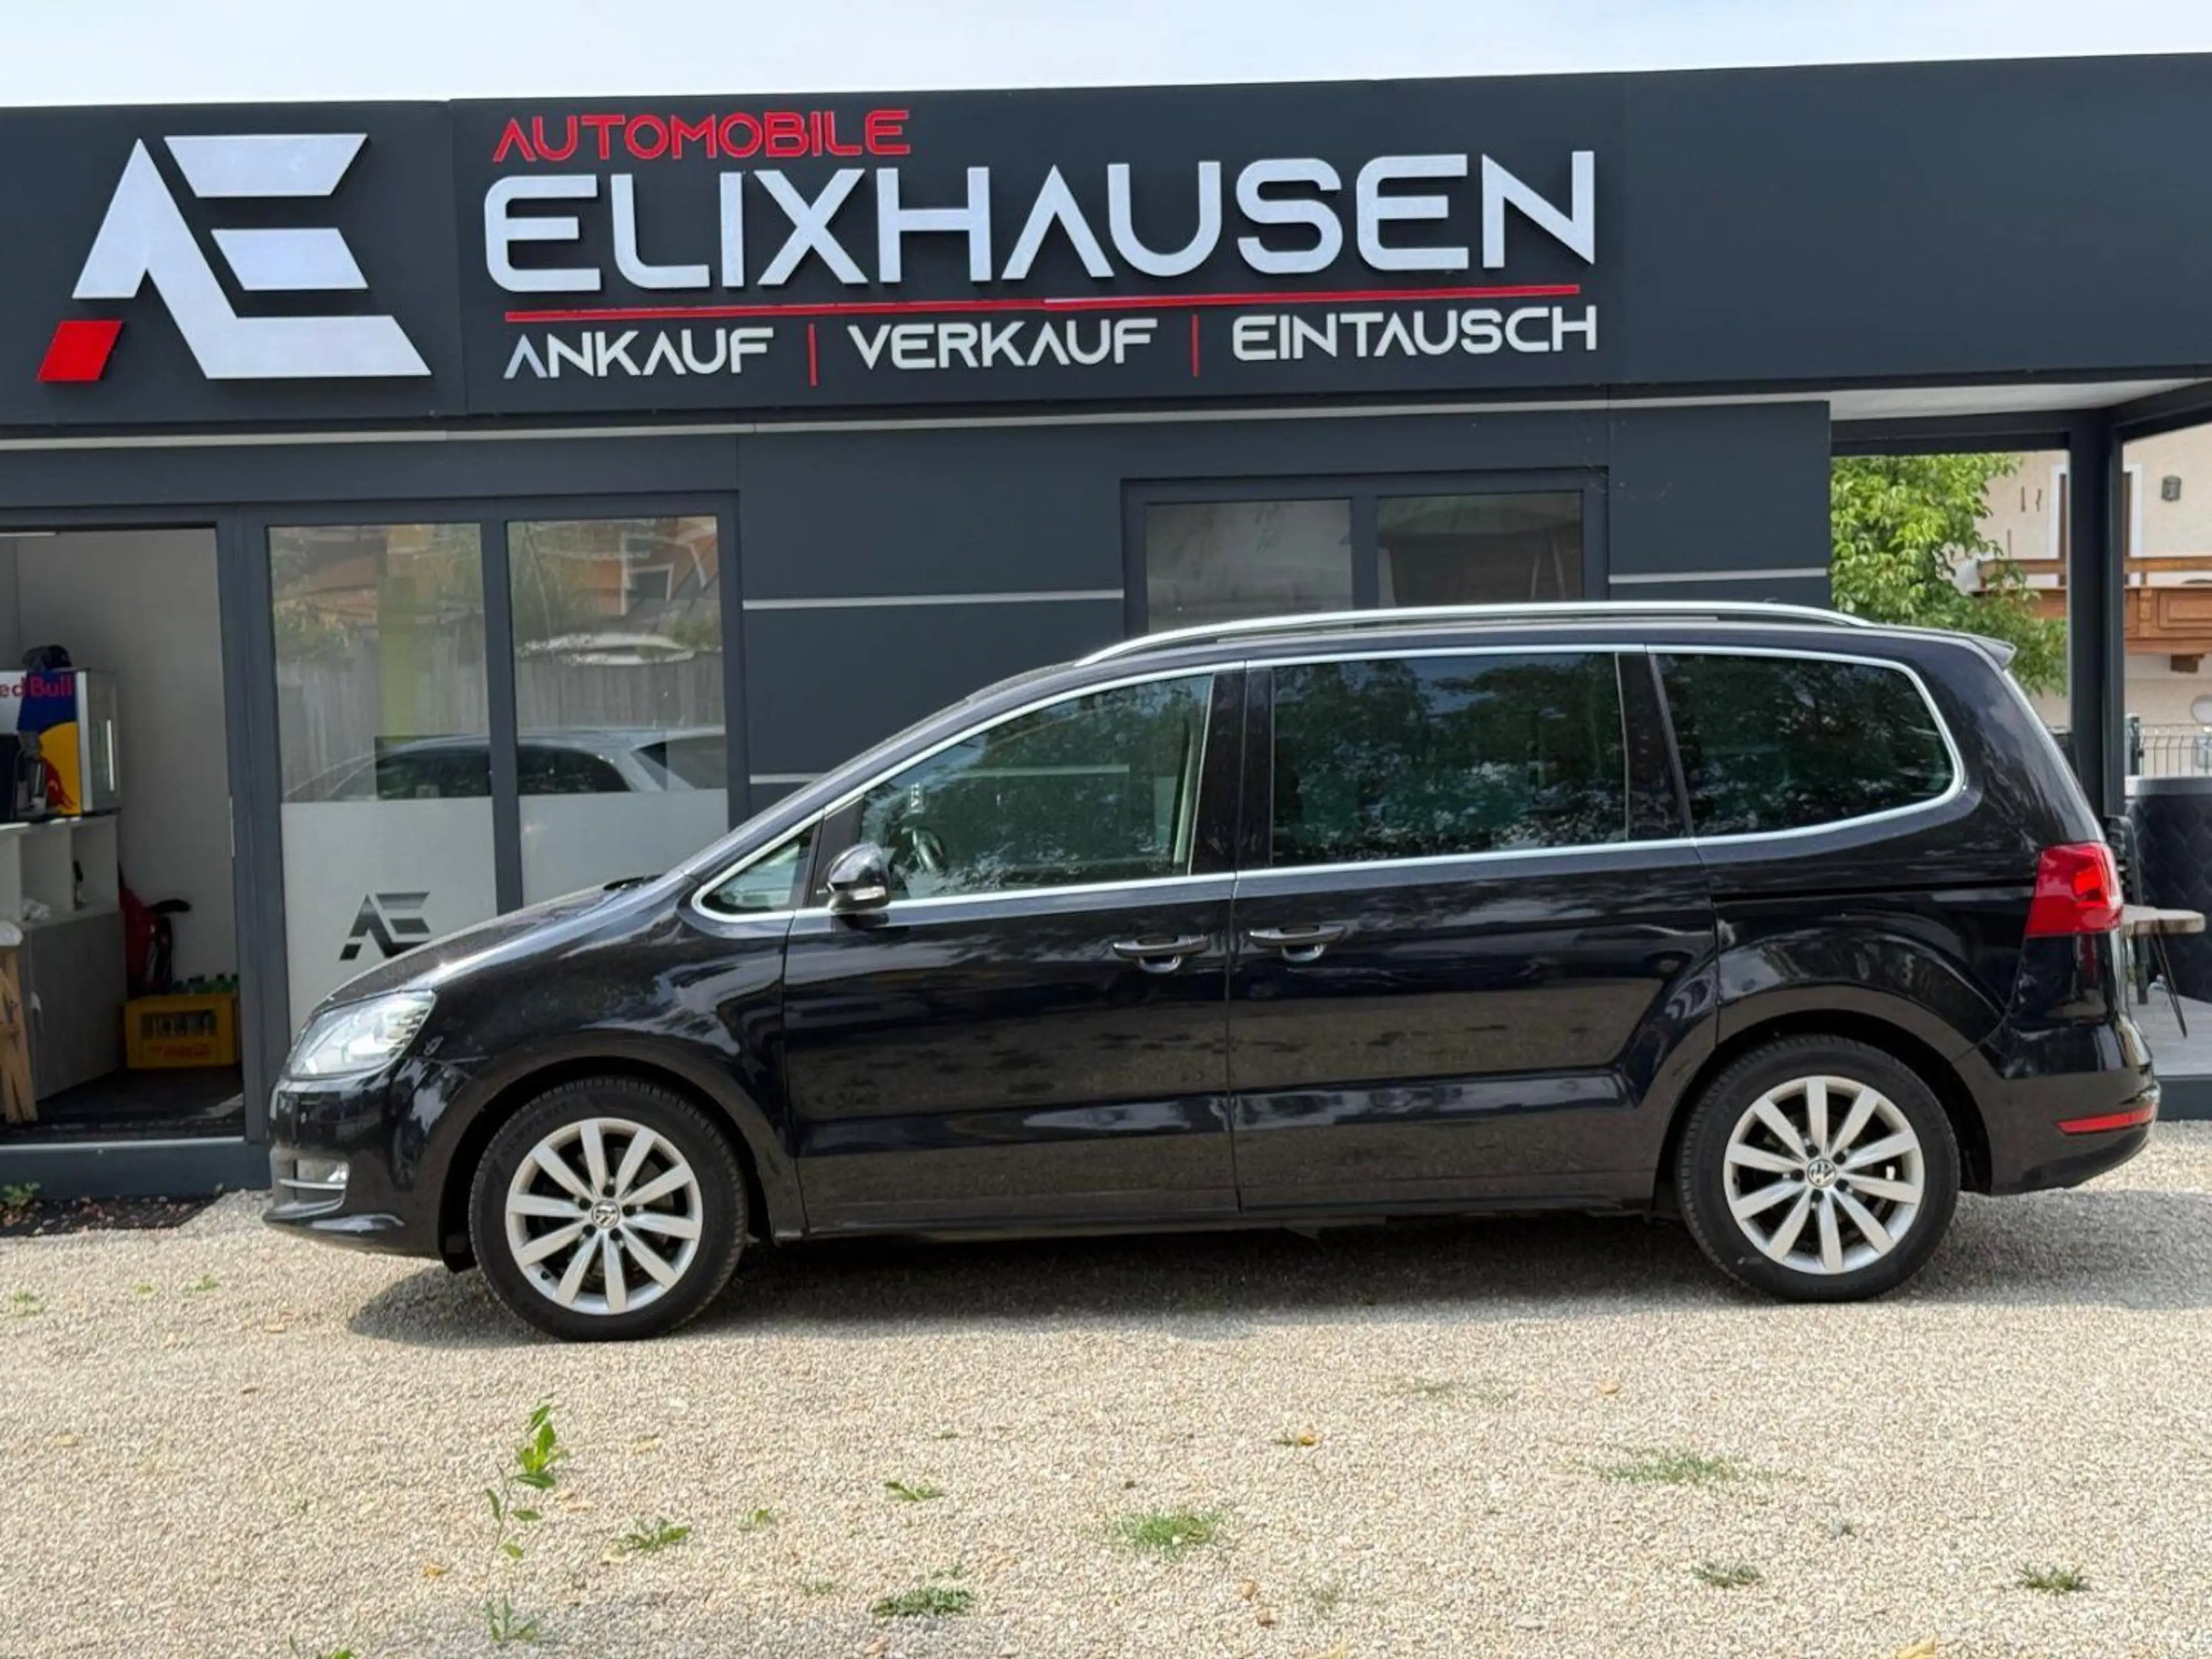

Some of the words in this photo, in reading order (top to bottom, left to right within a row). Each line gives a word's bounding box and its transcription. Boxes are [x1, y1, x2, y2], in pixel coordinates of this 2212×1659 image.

[493, 109, 911, 164] AUTOMOBILE
[484, 150, 1594, 293] ELIXHAUSEN
[504, 327, 774, 380] ANKAUF
[847, 317, 1158, 370] VERKAUF
[1232, 305, 1597, 361] EINTAUSCH
[0, 675, 27, 698] ed
[30, 673, 73, 698] Bull
